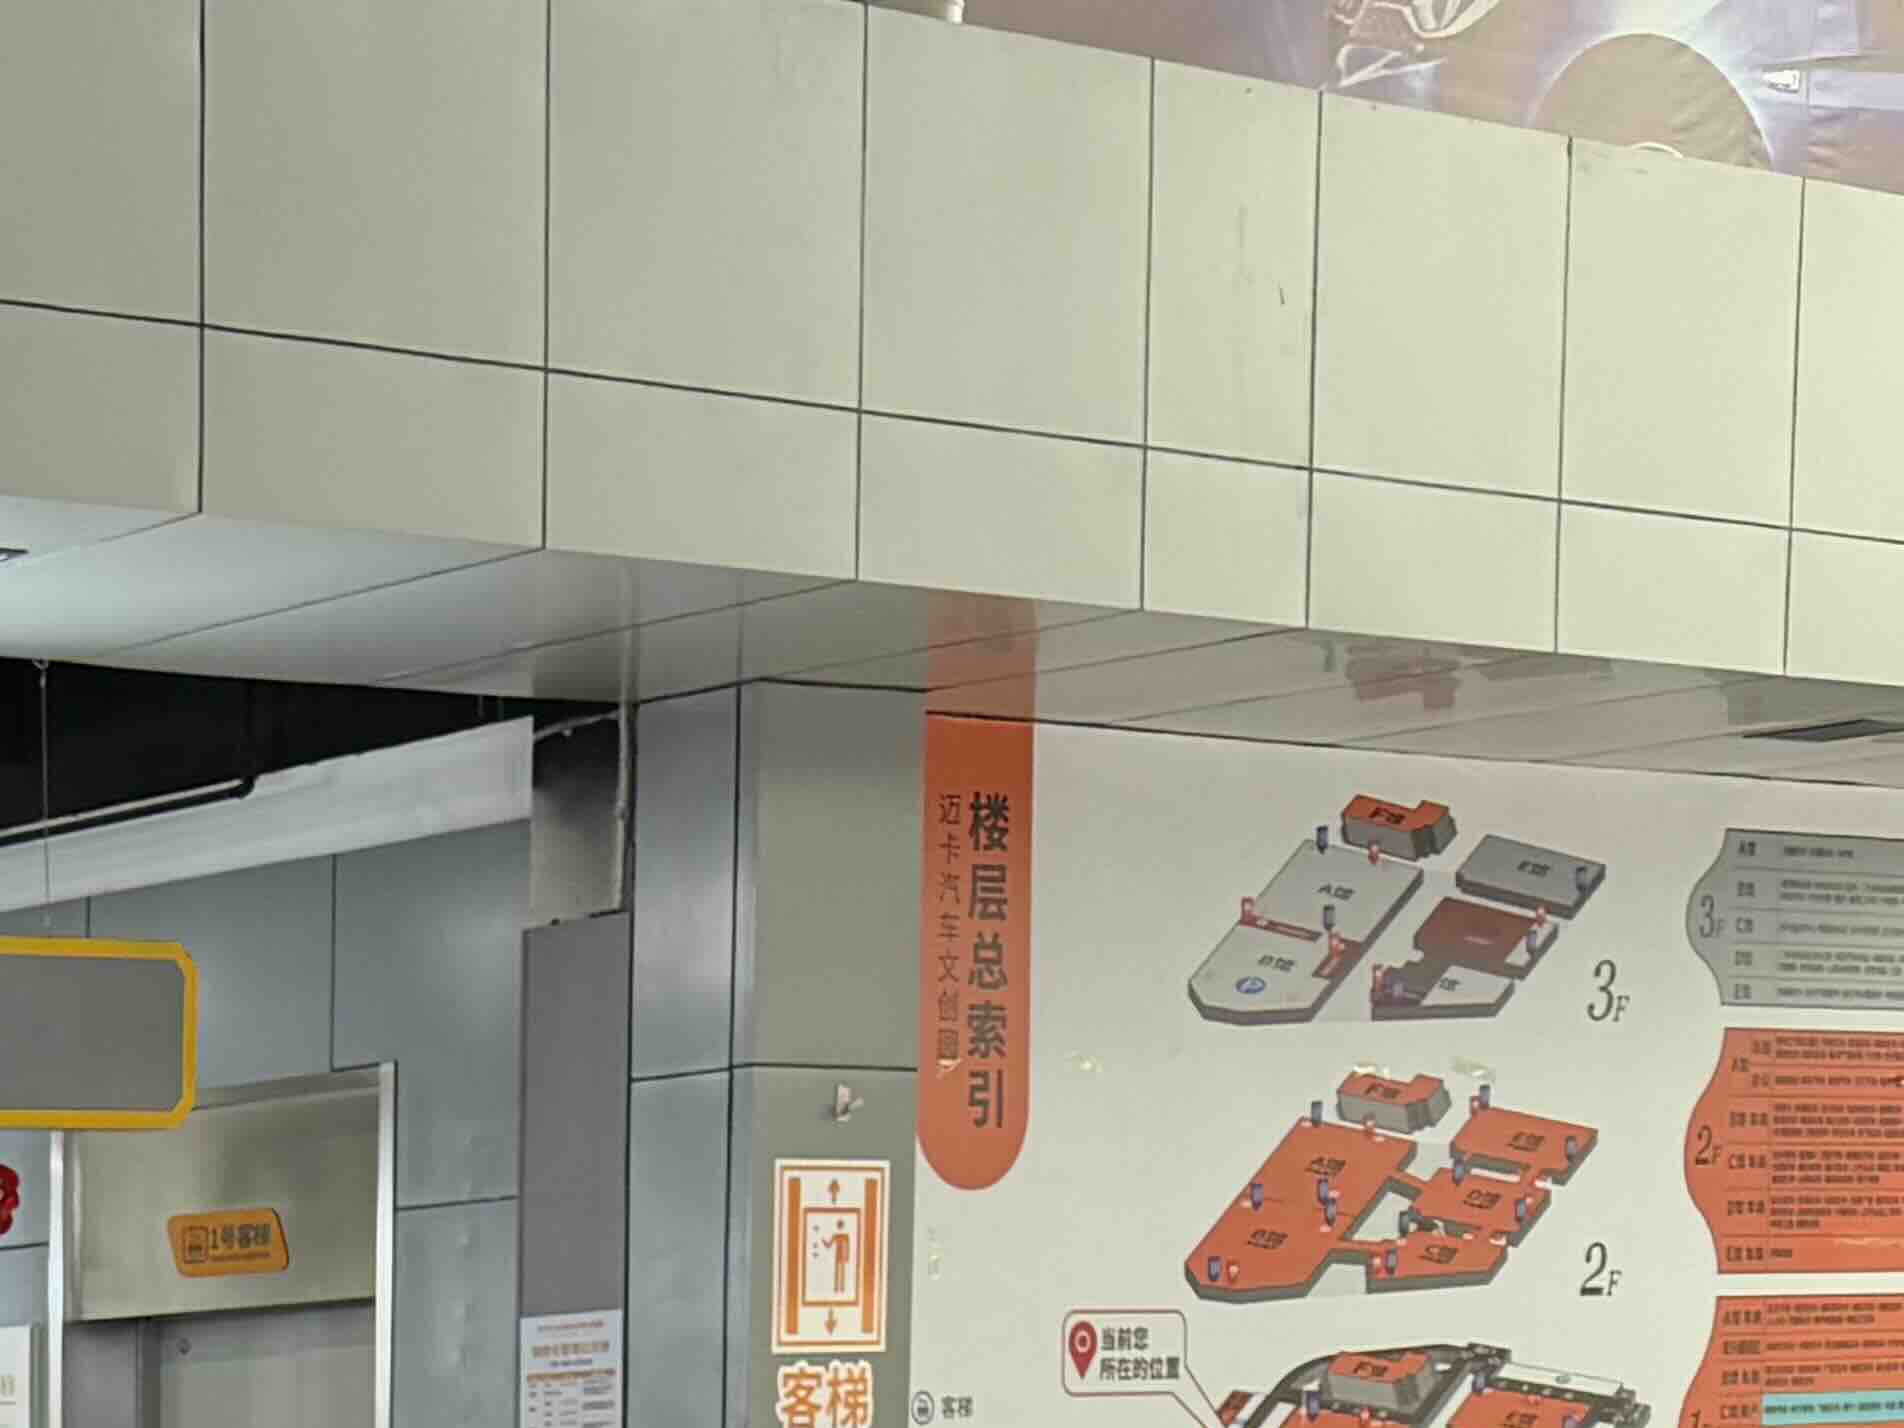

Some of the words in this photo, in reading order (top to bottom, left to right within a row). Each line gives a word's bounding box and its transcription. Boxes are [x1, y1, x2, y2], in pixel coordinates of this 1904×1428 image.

[967, 790, 1010, 1129] 楼层总索引
[1586, 958, 1631, 1022] 3F
[1579, 1241, 1622, 1297] 2F
[1100, 1327, 1150, 1349] 当前您
[1098, 1356, 1180, 1382] 所在的位置
